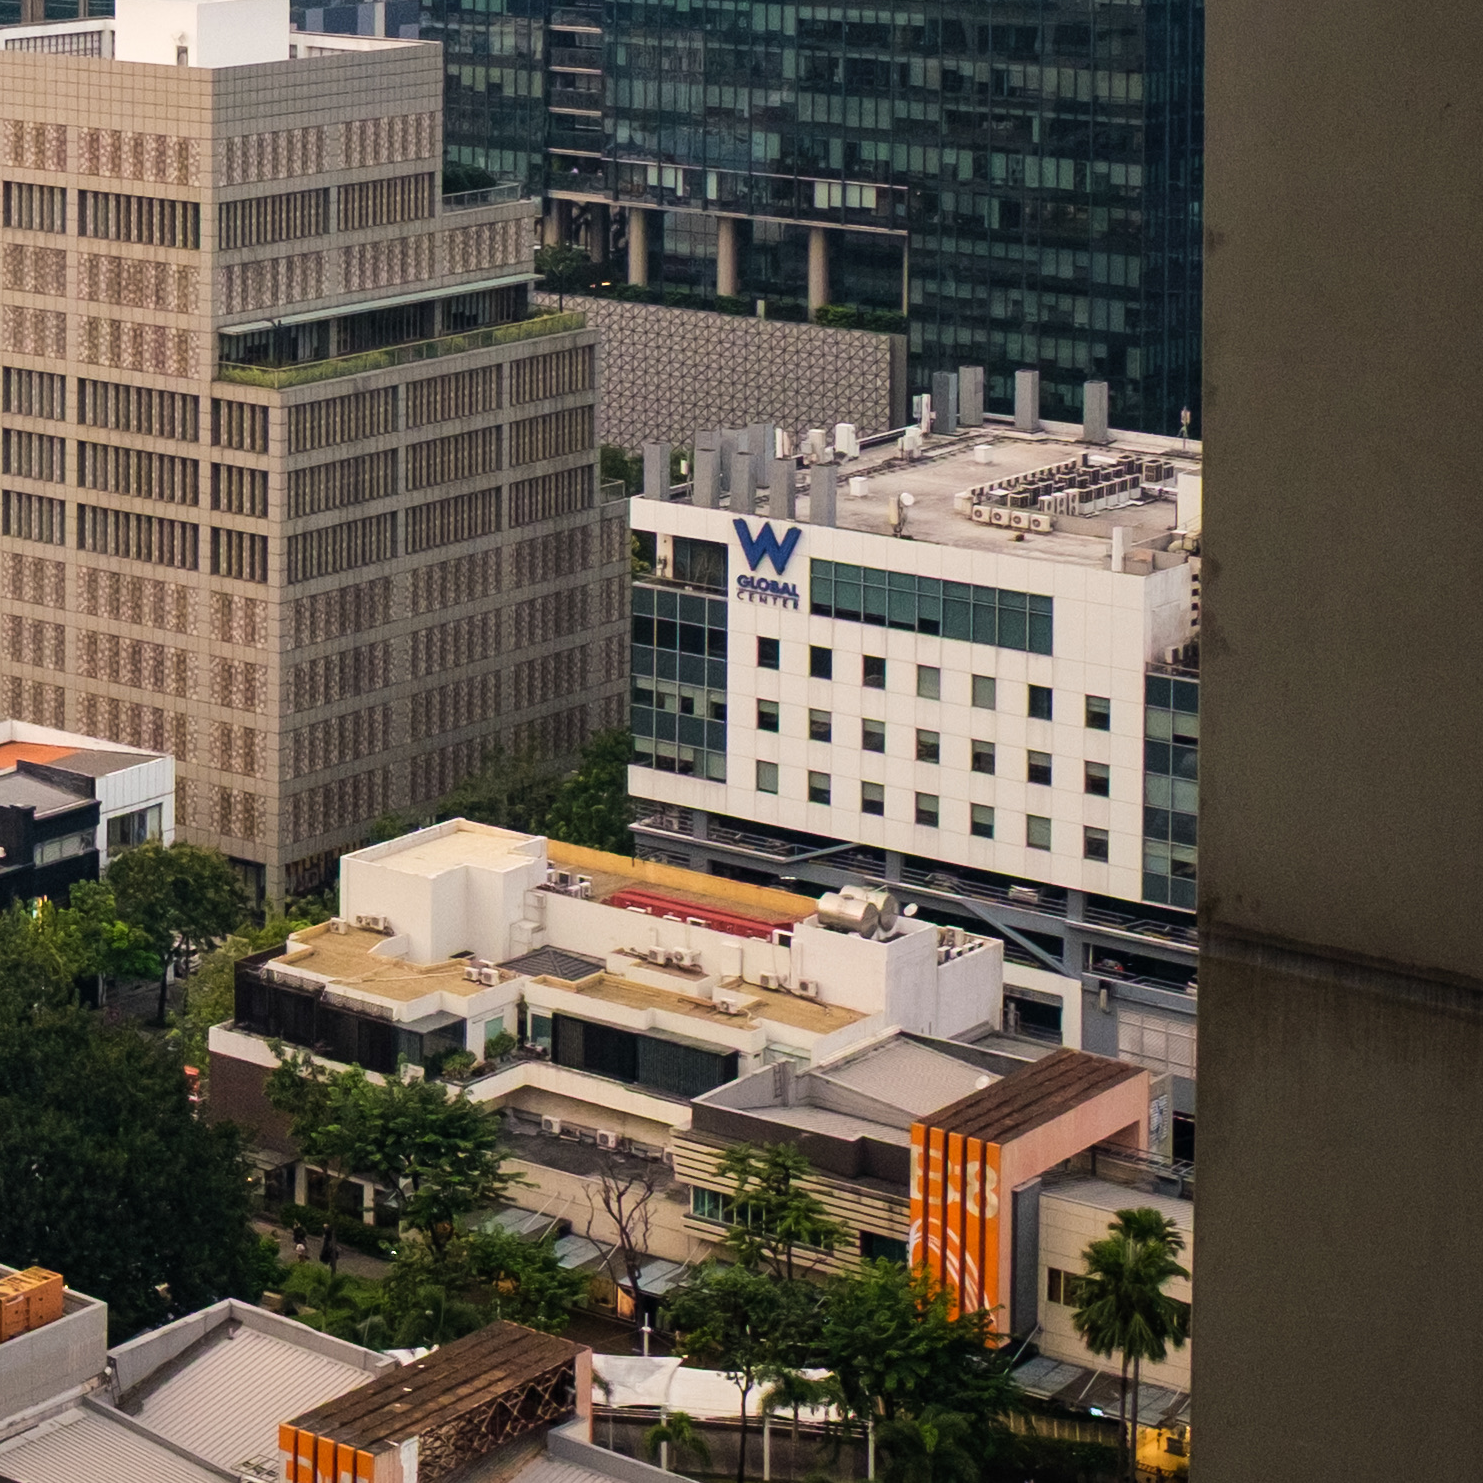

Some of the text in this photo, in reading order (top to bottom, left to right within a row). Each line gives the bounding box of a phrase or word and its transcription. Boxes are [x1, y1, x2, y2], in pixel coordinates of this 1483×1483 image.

[732, 518, 802, 575] W
[736, 574, 799, 597] GLOBAL
[736, 590, 799, 610] CENTER
